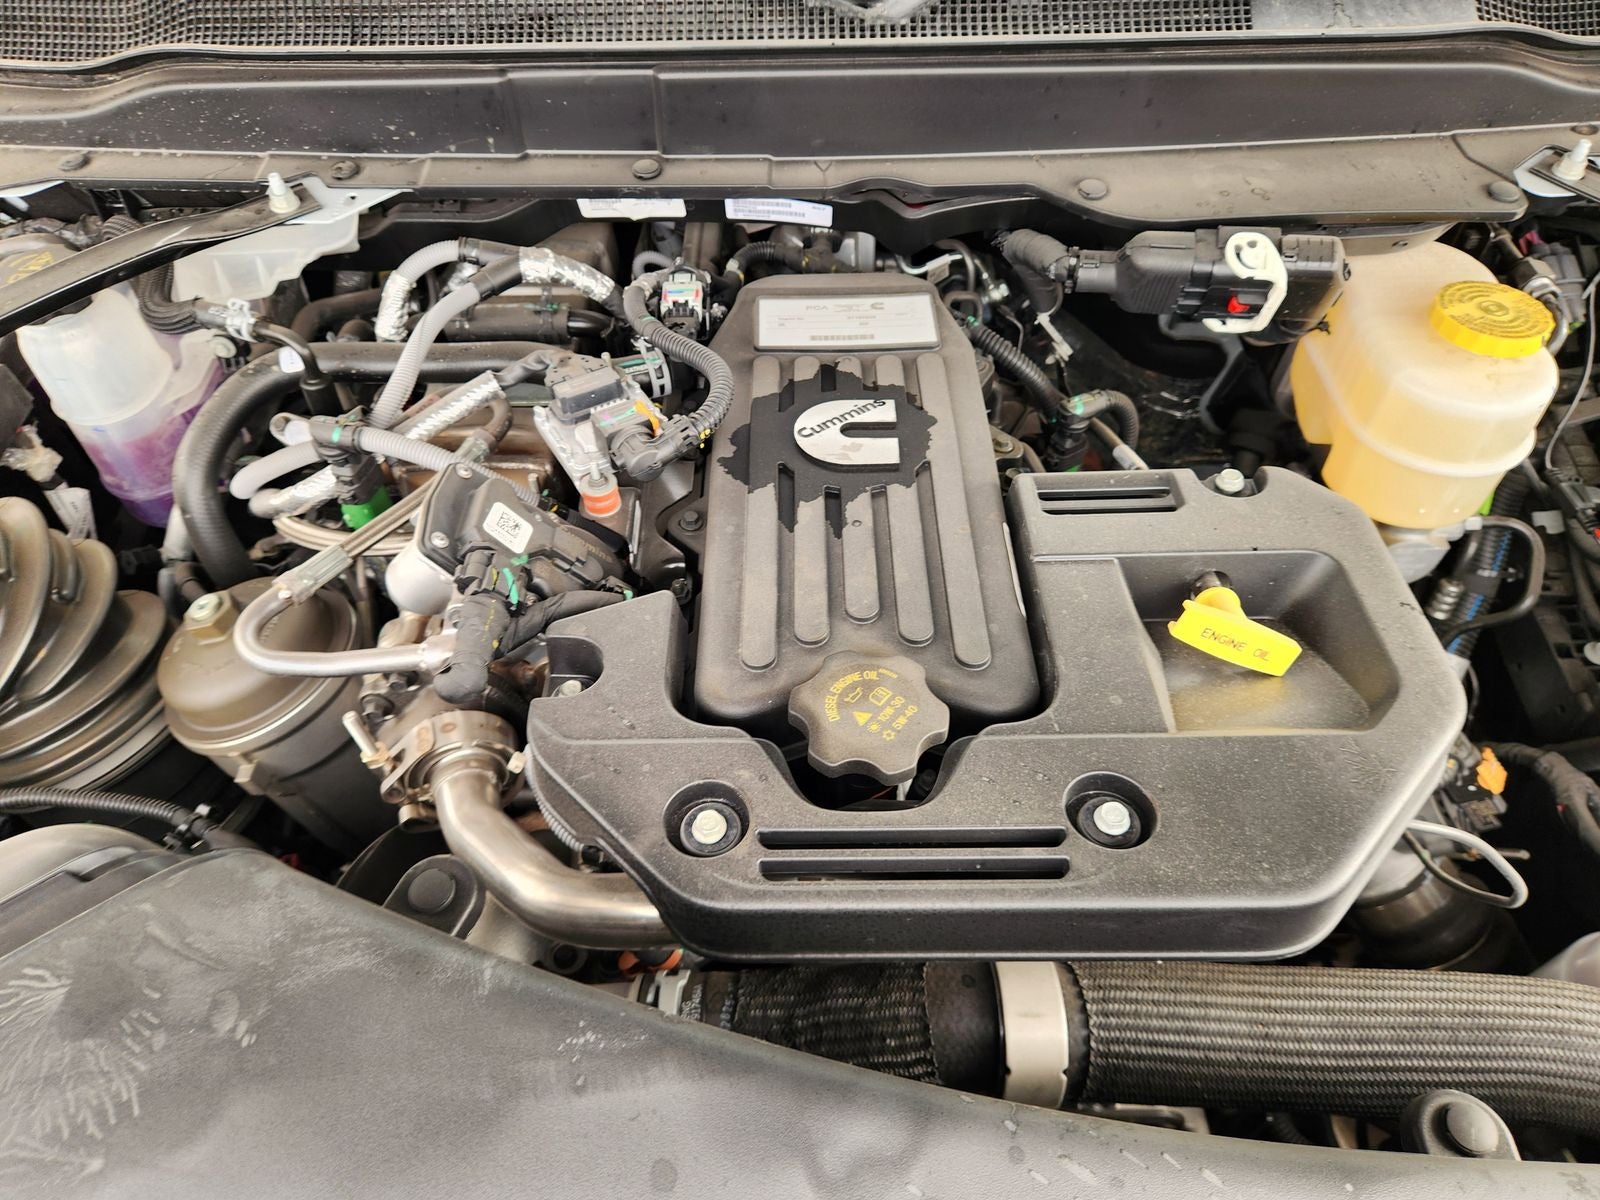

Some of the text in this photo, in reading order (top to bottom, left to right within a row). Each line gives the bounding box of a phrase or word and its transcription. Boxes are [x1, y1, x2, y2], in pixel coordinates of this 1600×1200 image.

[797, 399, 887, 439] Cummins
[1200, 627, 1271, 662] ENGINE OIL
[830, 671, 863, 694] ENGINE
[863, 670, 880, 681] OIL
[824, 695, 840, 722] DIESEL
